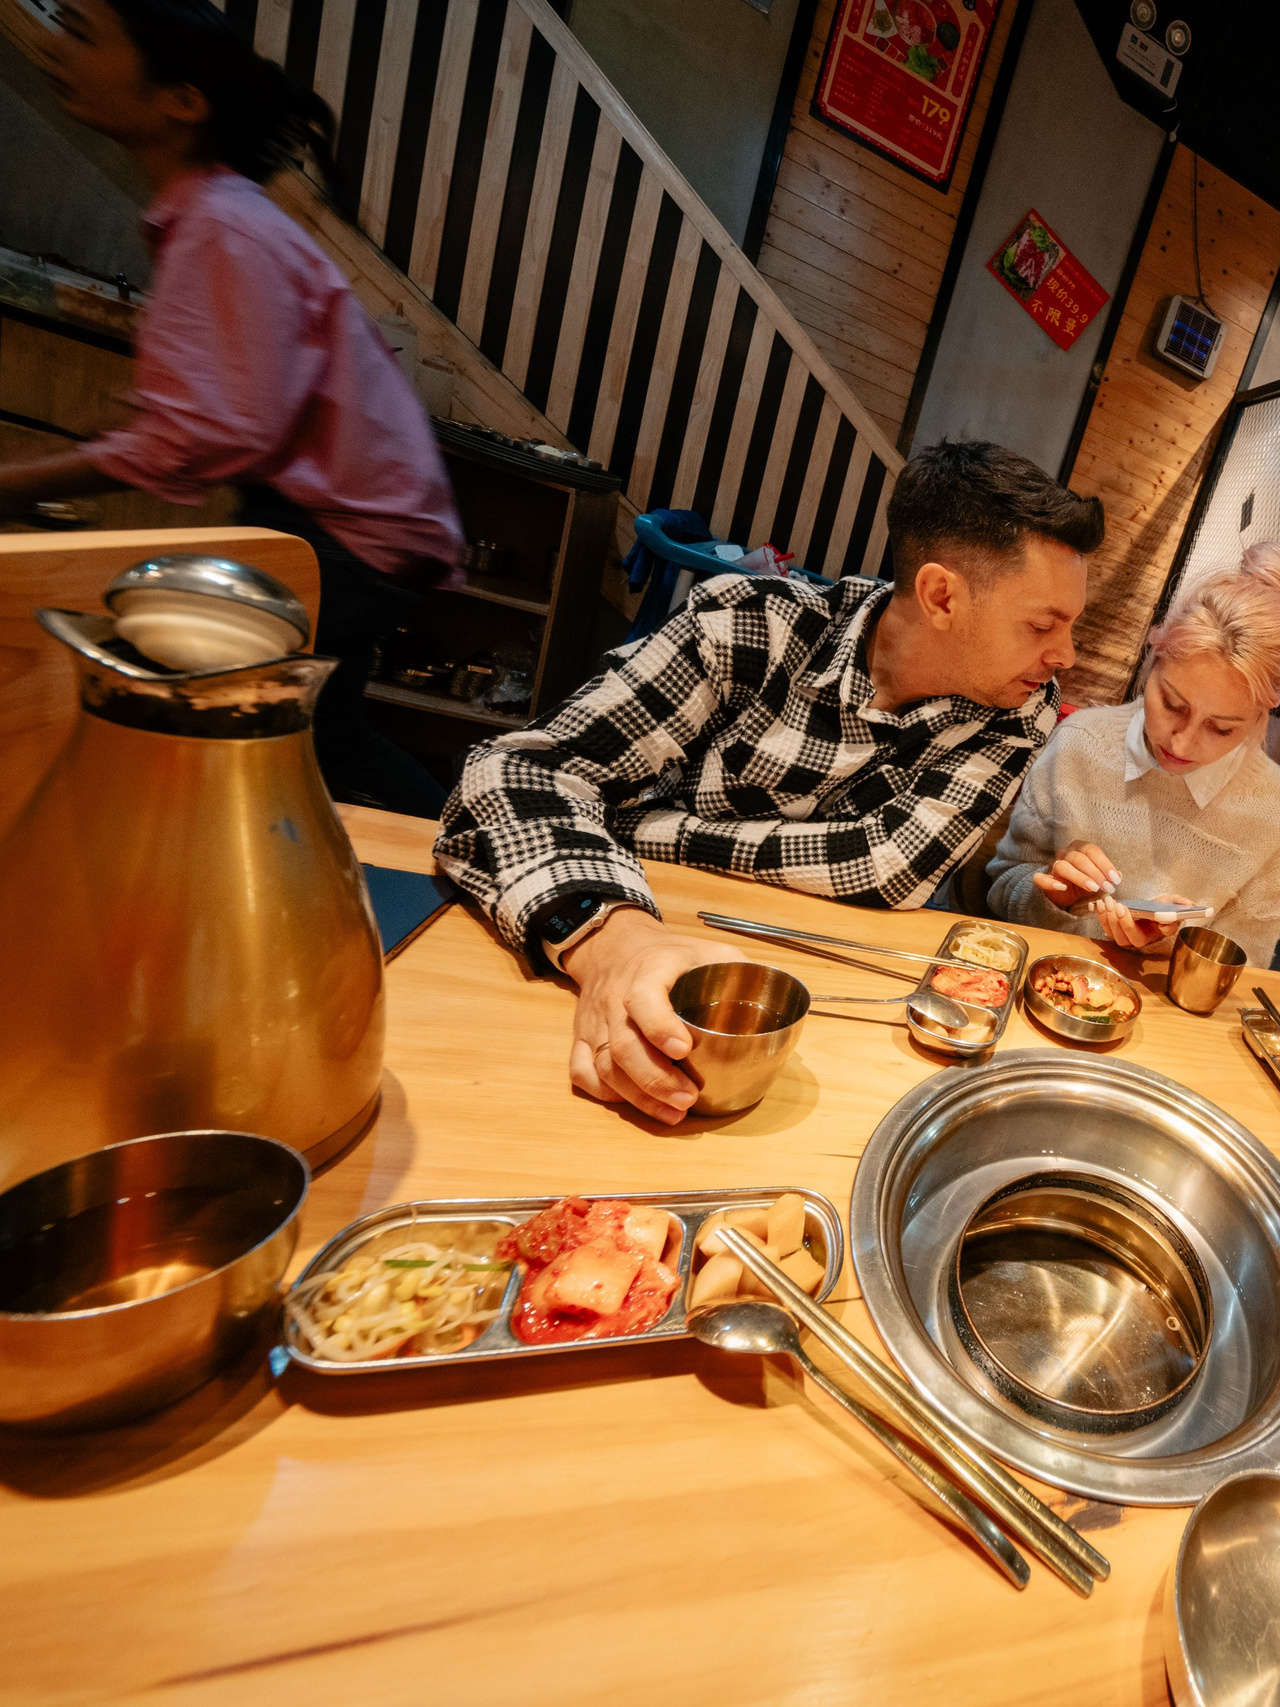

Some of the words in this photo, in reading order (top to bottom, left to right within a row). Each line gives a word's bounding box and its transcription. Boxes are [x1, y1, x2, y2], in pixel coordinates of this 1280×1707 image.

[922, 95, 950, 126] 179
[1031, 298, 1075, 337] 不限量
[1046, 277, 1089, 324] 现价39.9
